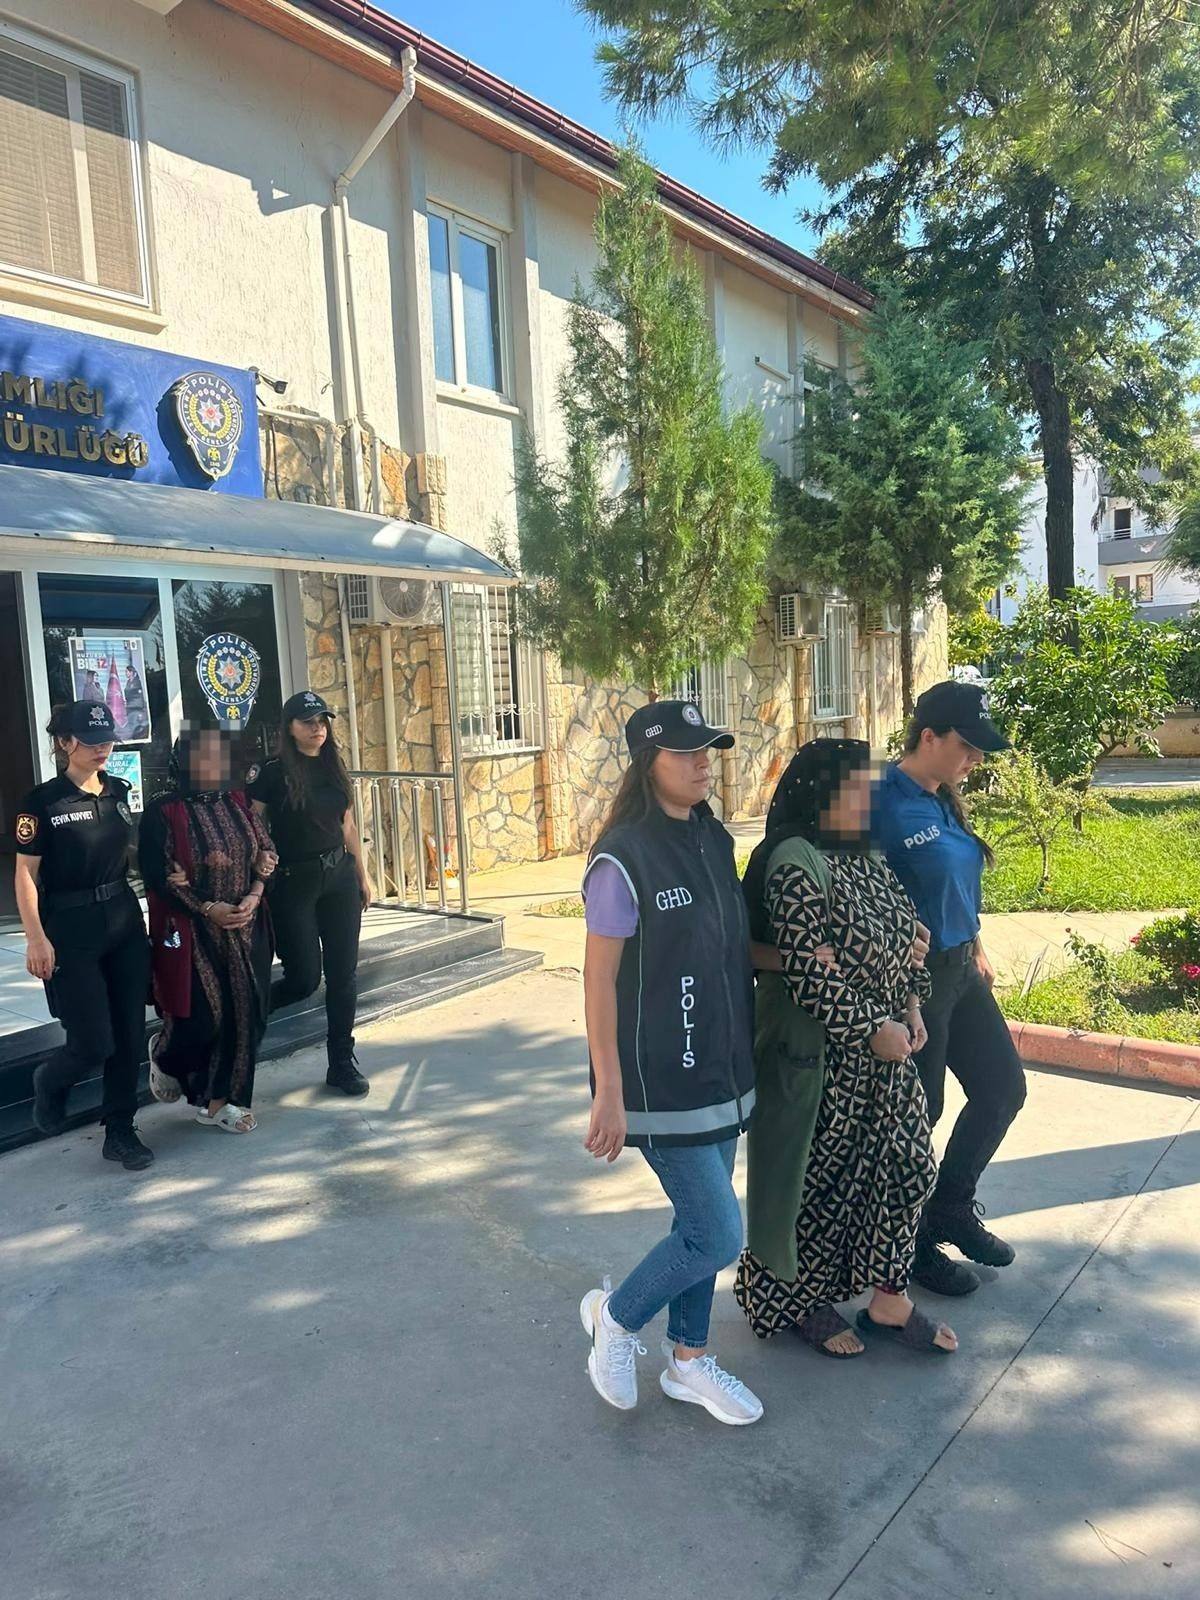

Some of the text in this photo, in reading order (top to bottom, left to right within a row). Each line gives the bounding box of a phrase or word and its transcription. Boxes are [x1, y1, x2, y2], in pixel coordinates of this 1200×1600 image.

[0, 371, 105, 417] MLIĞI
[645, 724, 663, 738] GHD
[655, 887, 693, 911] GHD
[681, 976, 696, 1068] POLİS
